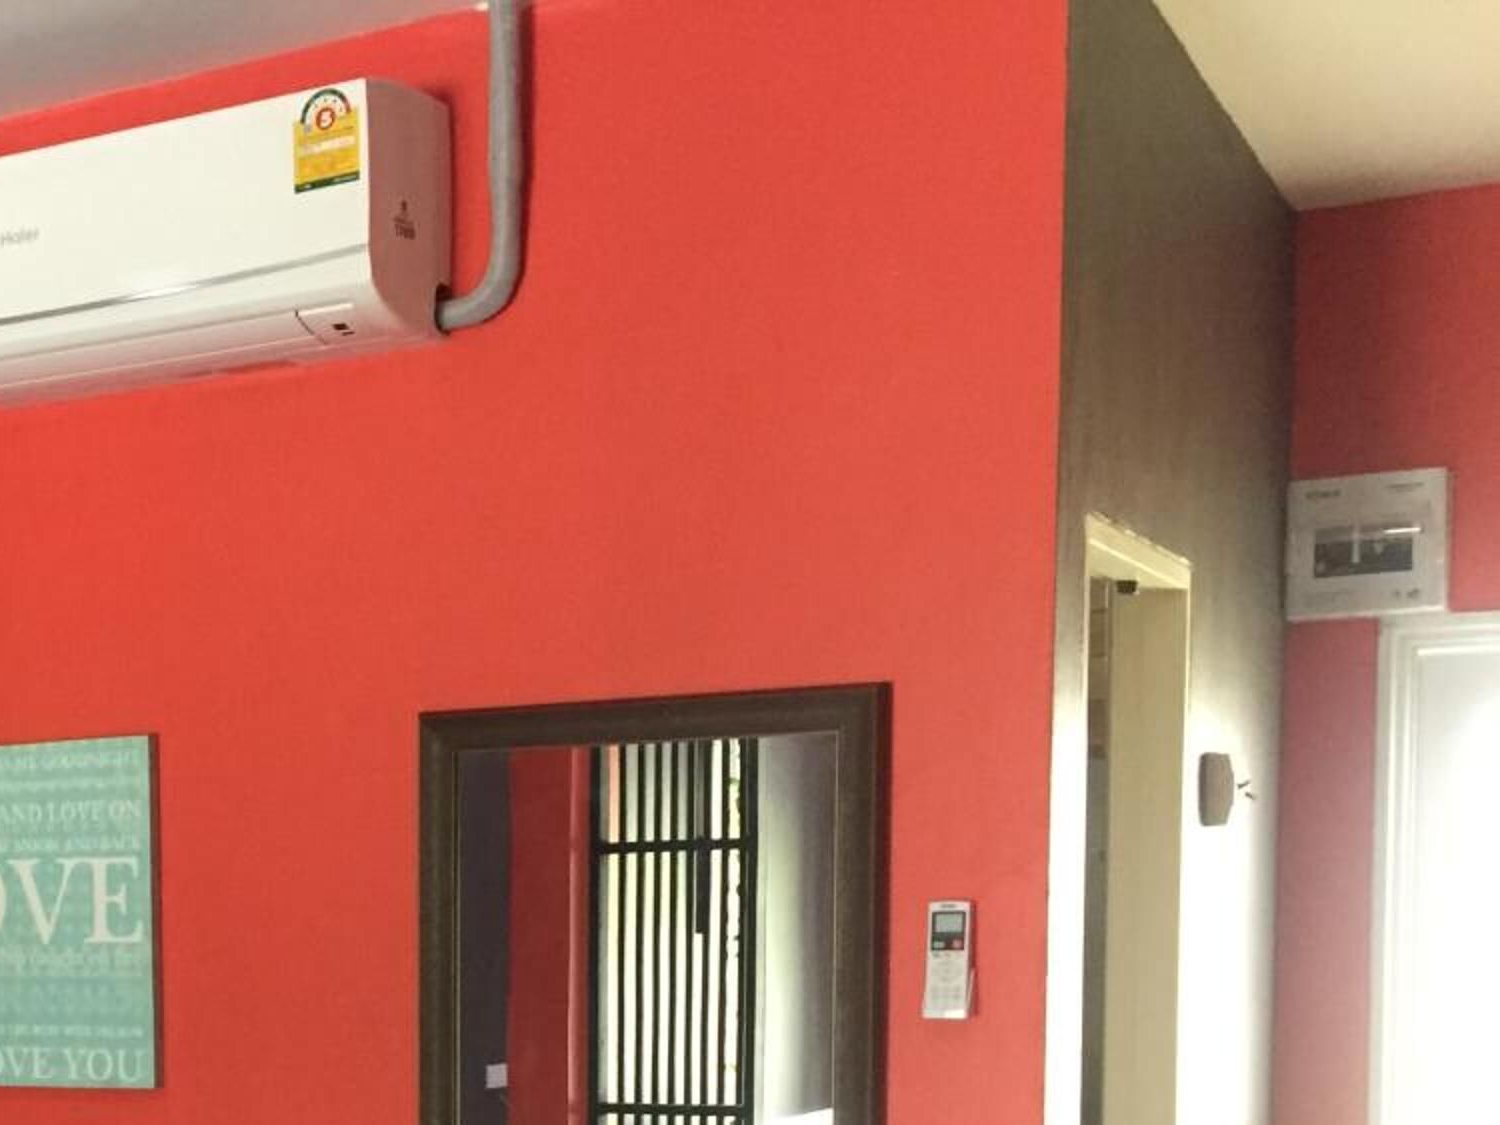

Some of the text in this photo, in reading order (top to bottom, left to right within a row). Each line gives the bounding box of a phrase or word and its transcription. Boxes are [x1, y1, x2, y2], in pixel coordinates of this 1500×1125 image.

[0, 802, 43, 826] AND
[47, 800, 101, 824] LOVE
[108, 799, 140, 819] ON
[63, 1048, 144, 1082] YOU
